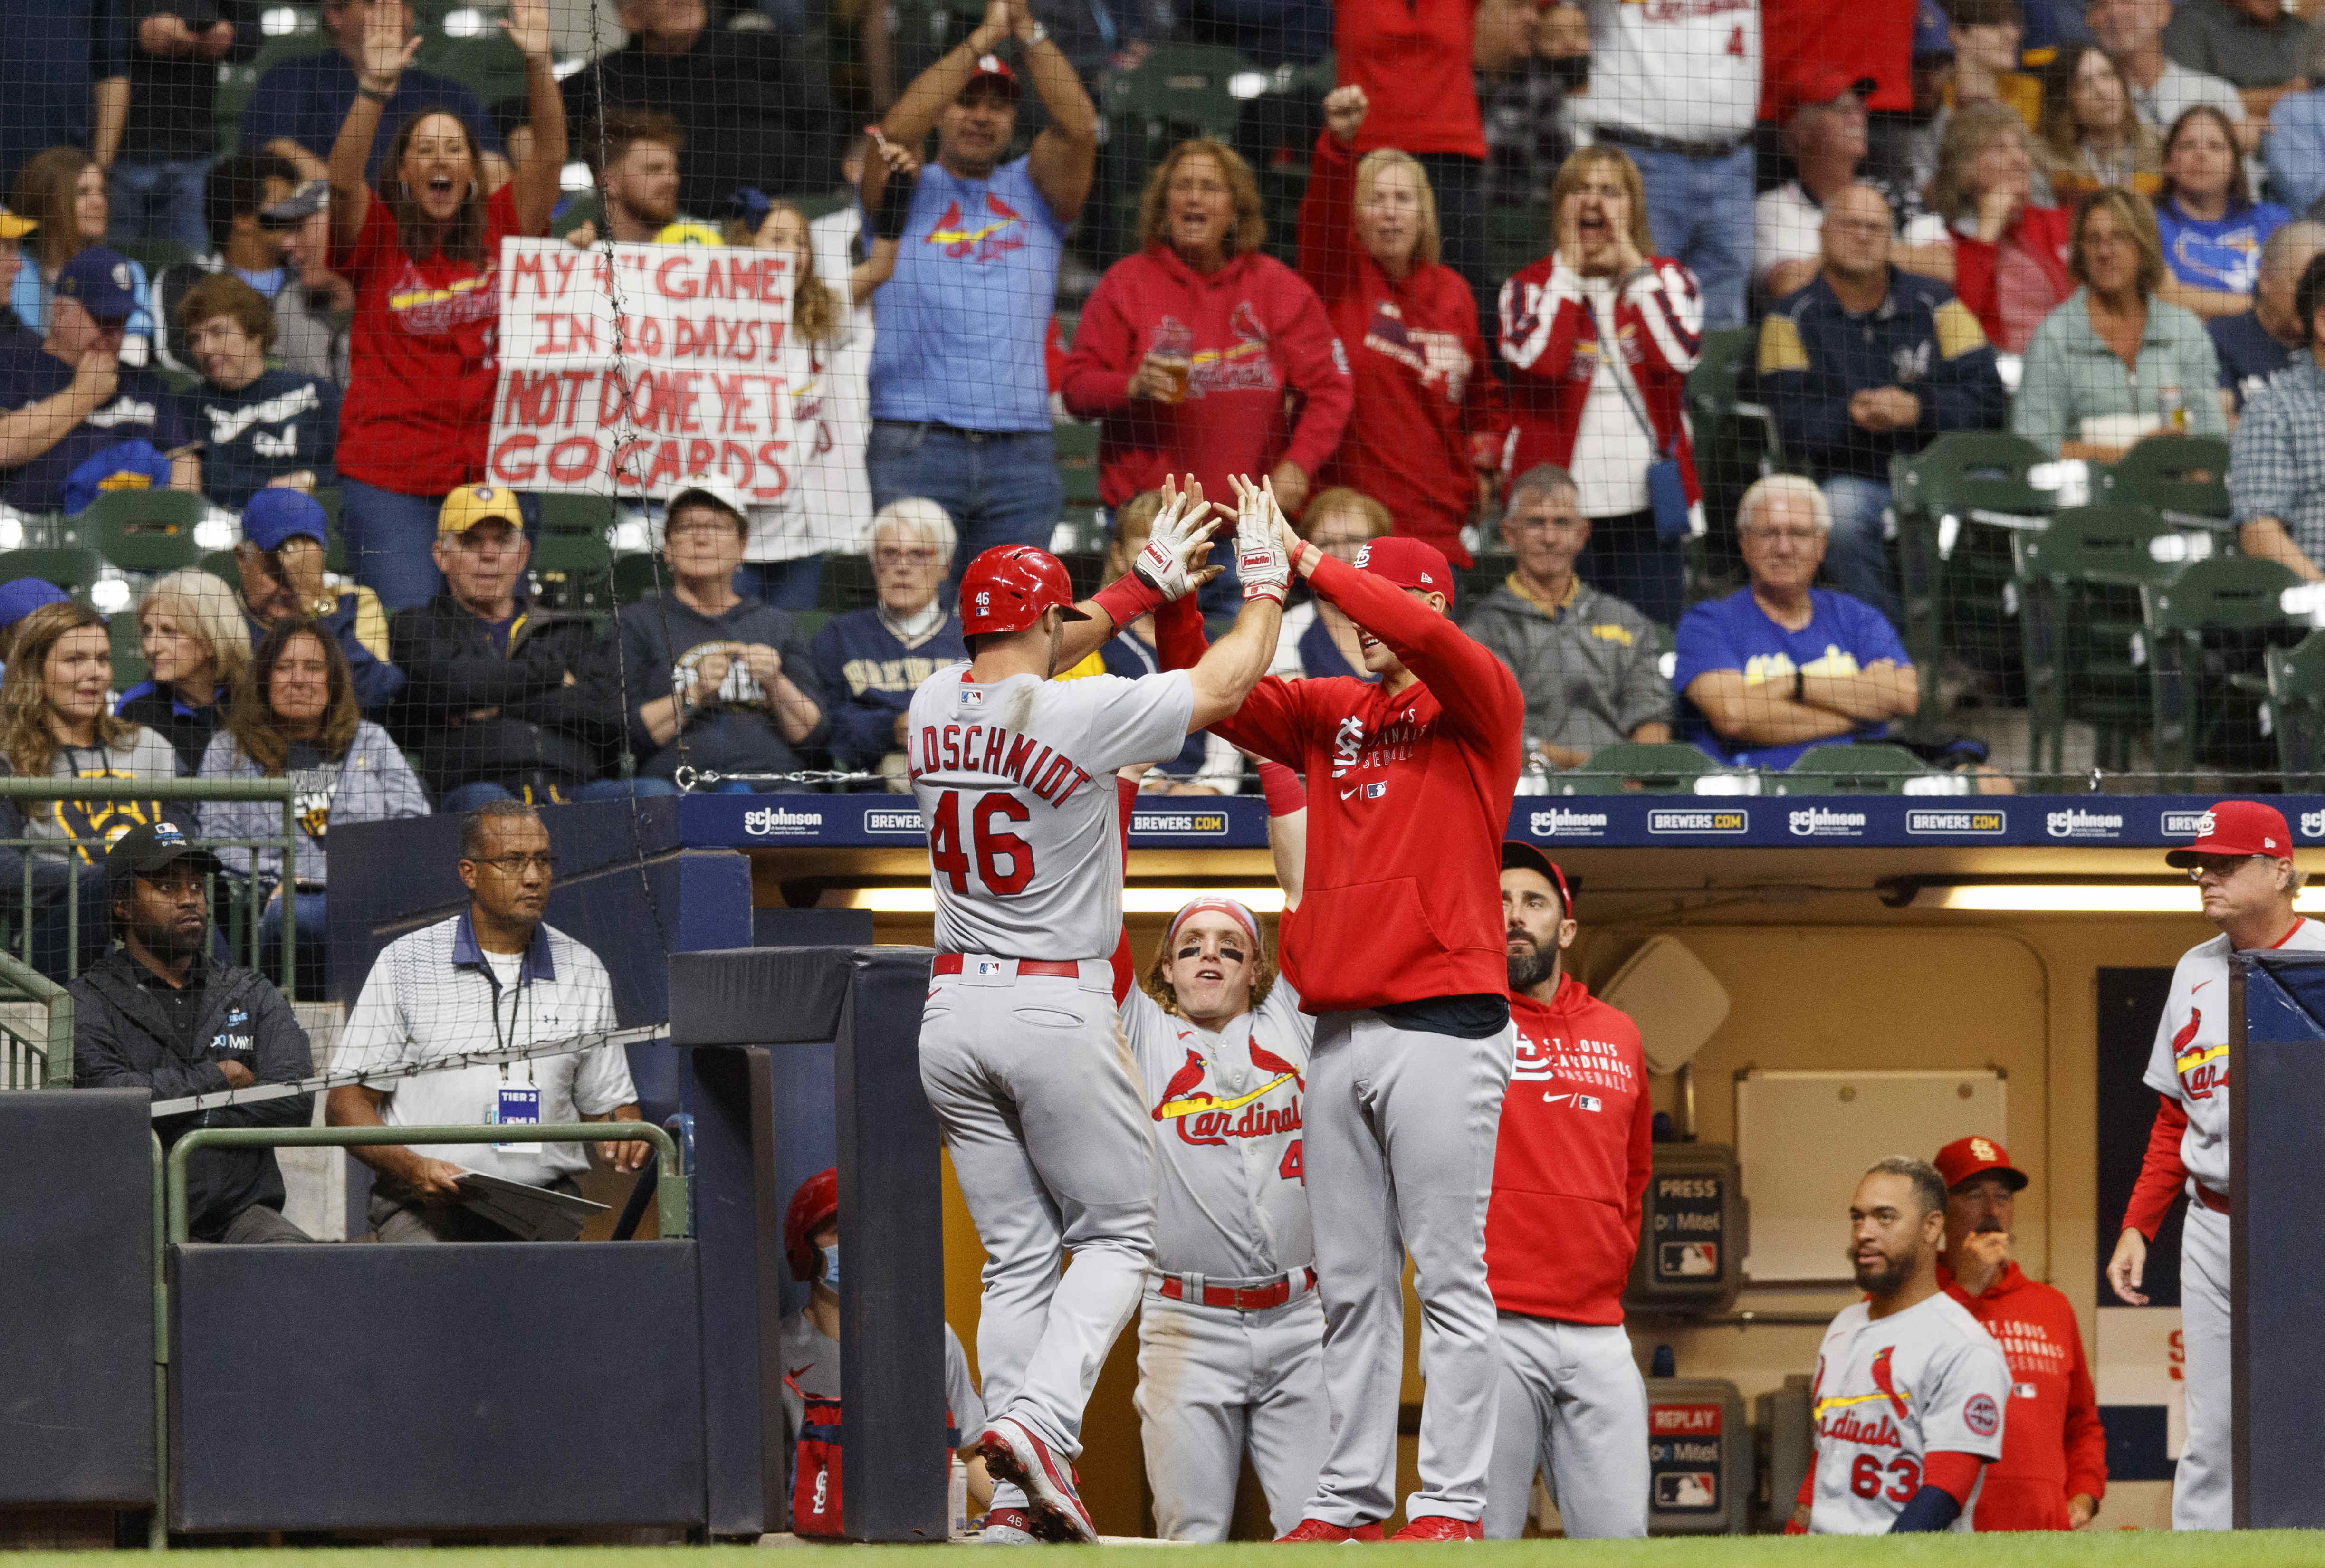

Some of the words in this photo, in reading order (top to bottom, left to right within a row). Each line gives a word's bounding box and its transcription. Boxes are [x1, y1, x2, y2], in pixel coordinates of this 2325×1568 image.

[510, 253, 577, 300] MY
[655, 256, 787, 305] GAME
[535, 313, 596, 354] IN
[615, 315, 663, 357] 10
[673, 316, 785, 363] DAYS!
[502, 369, 594, 427] NOT
[599, 370, 703, 433] DONE
[711, 372, 786, 434] YET
[492, 434, 599, 482] GO
[611, 440, 789, 498] CARDS
[1144, 544, 1164, 565] Franklin
[1243, 556, 1269, 568] Franklin
[975, 591, 990, 606] 46
[1133, 816, 1221, 830] BREWERS.COM
[1654, 814, 1741, 829] BREWERS.COM
[1913, 814, 1999, 830] BREWERS.COM
[930, 790, 1036, 896] 46
[2179, 1047, 2229, 1100] Car
[501, 1092, 527, 1102] TIER
[528, 1093, 537, 1102] 2
[1176, 1092, 1303, 1146] Cardinal
[1279, 1139, 1305, 1186] 4
[1659, 1179, 1717, 1198] PRESS
[1655, 1410, 1714, 1428] REPLAY
[1851, 1453, 1921, 1503] 63
[1007, 1514, 1023, 1527] 46
